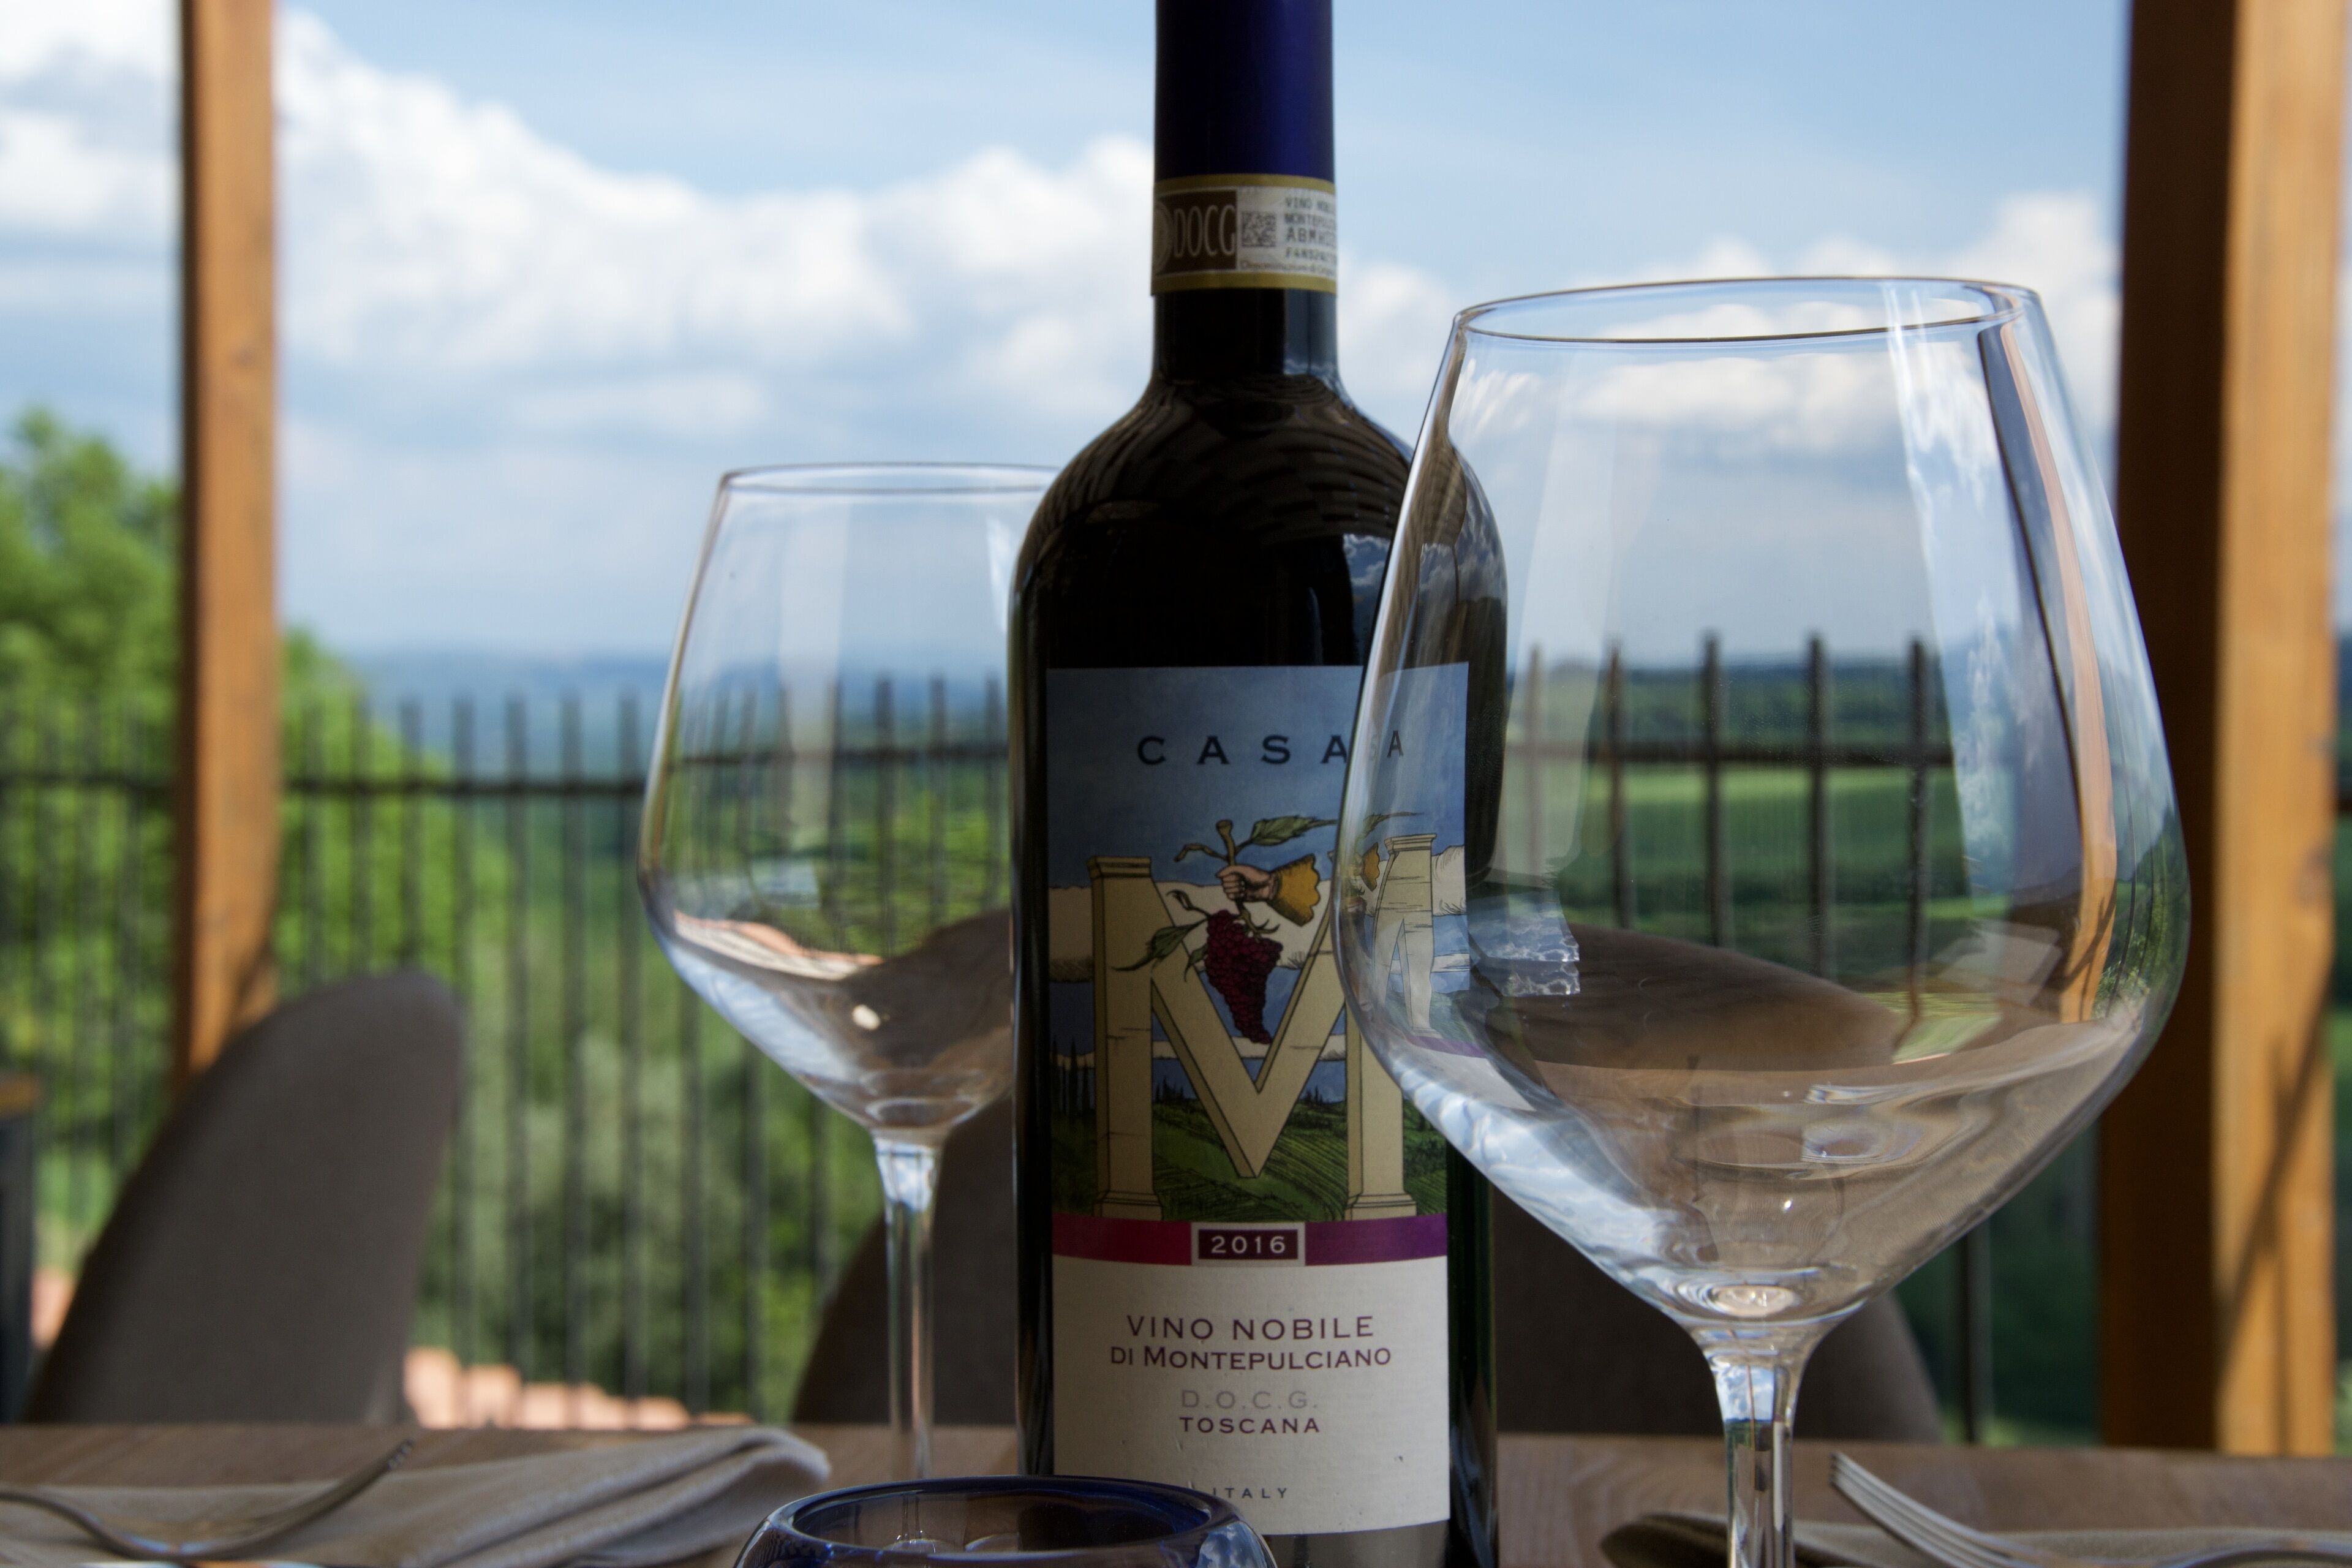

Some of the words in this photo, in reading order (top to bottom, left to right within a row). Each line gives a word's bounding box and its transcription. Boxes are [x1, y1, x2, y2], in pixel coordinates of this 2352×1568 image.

[1173, 204, 1235, 258] DOCG
[1137, 734, 1348, 766] CASA
[1210, 1235, 1286, 1254] 2016
[1127, 1315, 1214, 1340] VINO
[1232, 1316, 1374, 1341] NOBILE
[1110, 1346, 1133, 1365] DI
[1144, 1346, 1392, 1371] MONTEPULCIANO
[1181, 1389, 1318, 1410] D.O.C.G.
[1179, 1417, 1321, 1434] TOSCANA
[1212, 1487, 1288, 1499] ITALY
